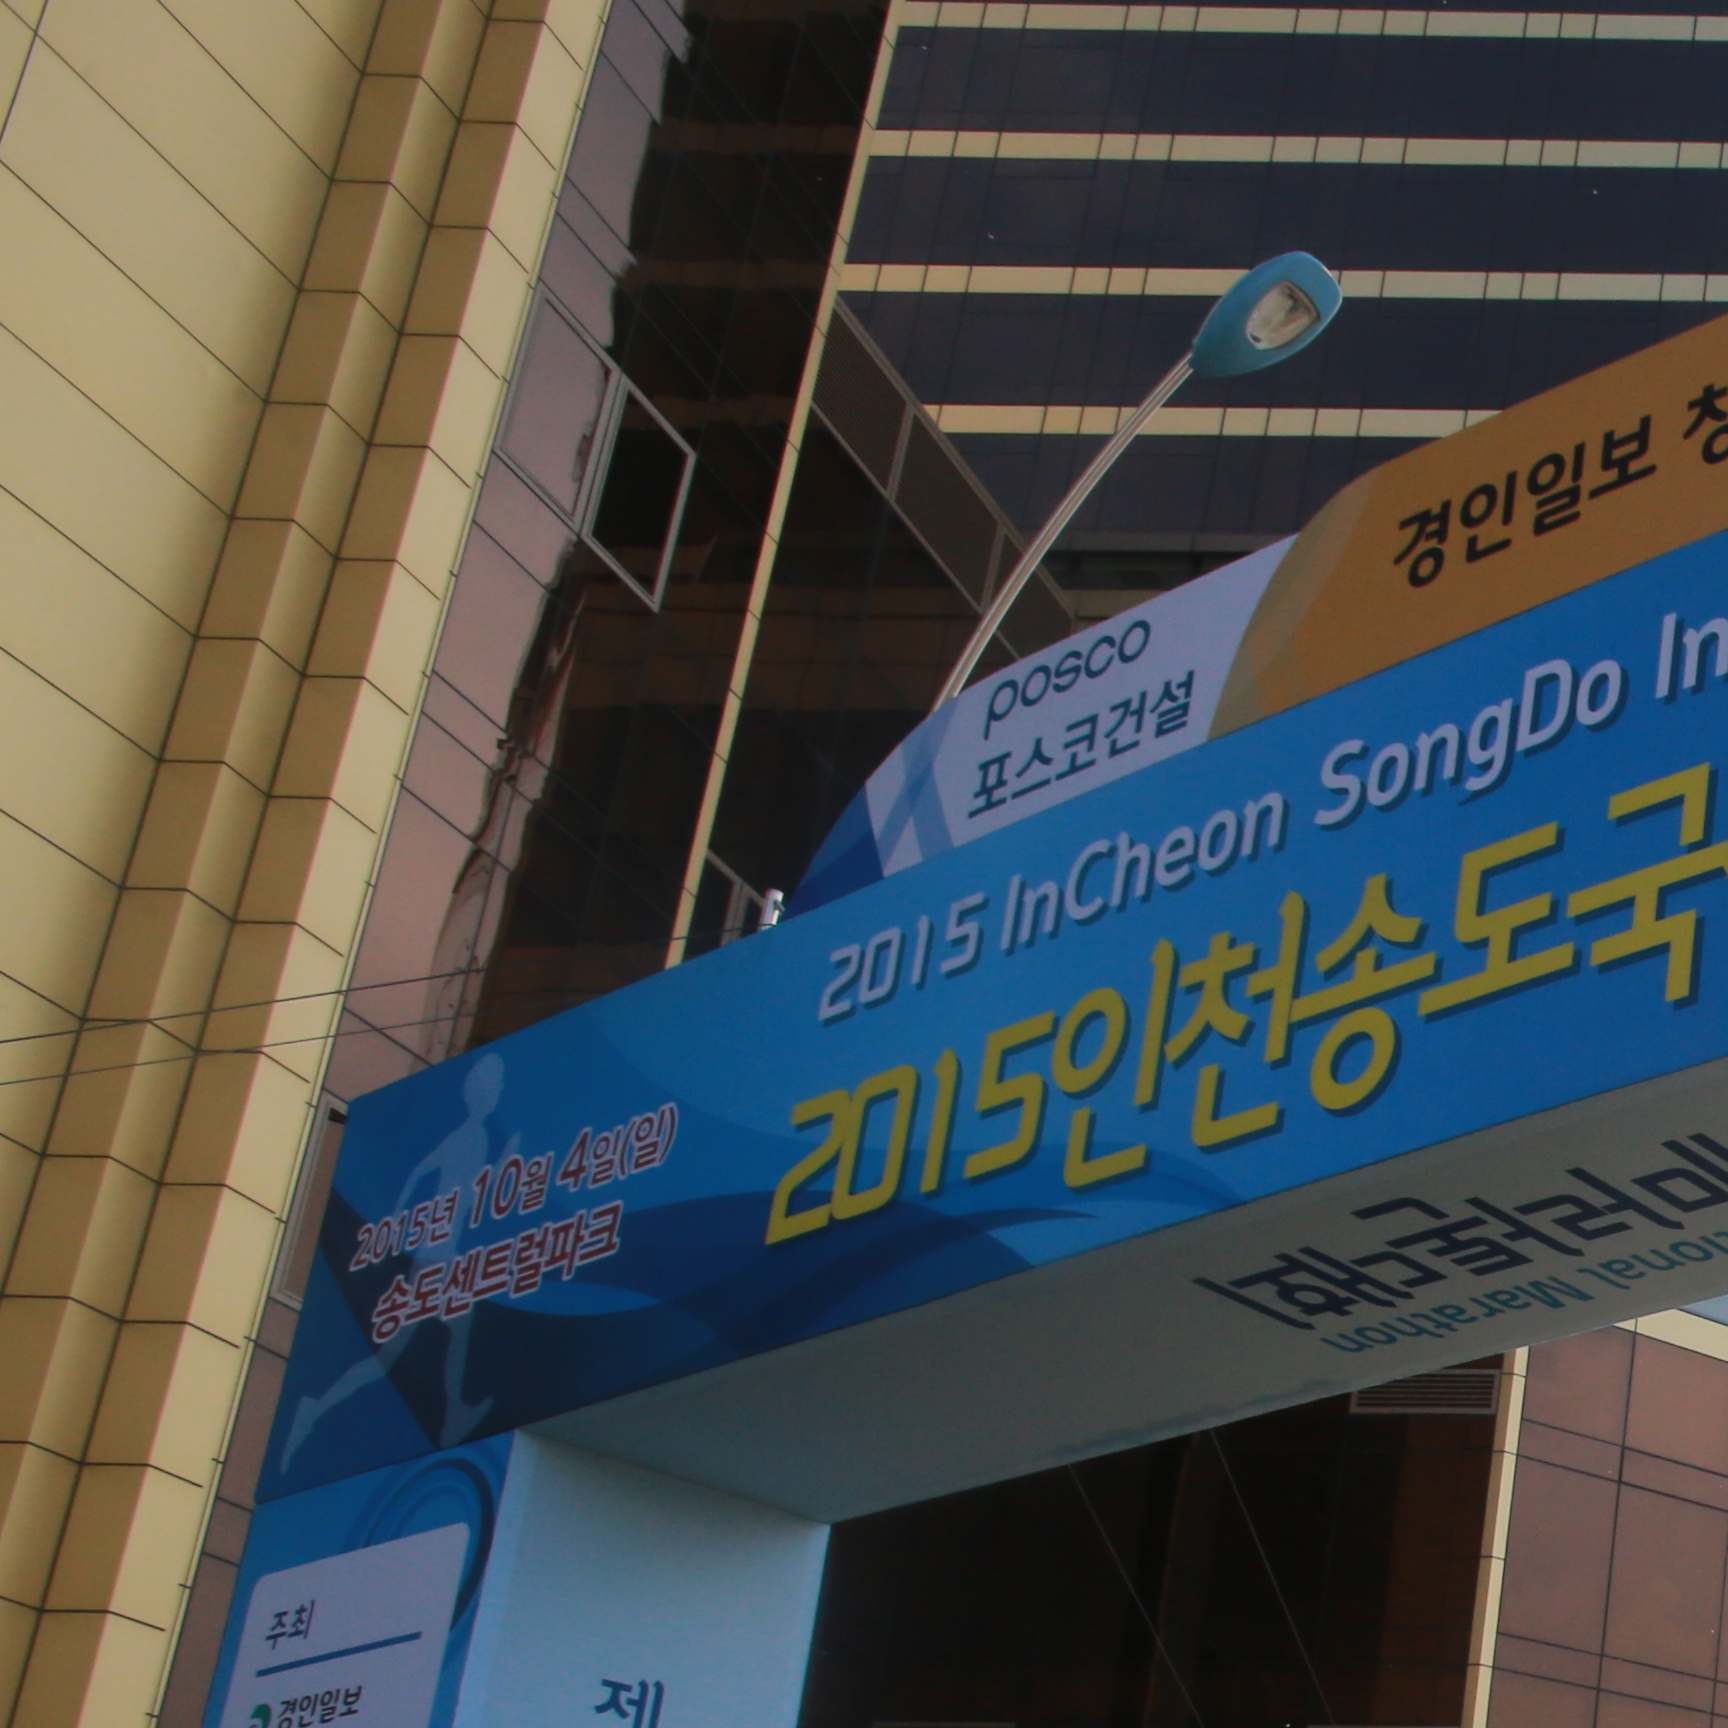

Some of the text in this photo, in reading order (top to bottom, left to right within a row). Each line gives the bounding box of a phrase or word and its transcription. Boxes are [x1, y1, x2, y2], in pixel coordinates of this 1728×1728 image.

[1392, 413, 1659, 591] 경인일보
[966, 670, 1196, 819] 포스코건설
[982, 620, 1150, 740] posco
[818, 892, 982, 1022] 2015
[1002, 794, 1285, 950] InCheon
[1314, 655, 1625, 827] SongDo
[350, 1103, 677, 1271] 2015년 10월 4일(일)
[373, 1201, 623, 1343] 송도센트럴파크
[1320, 1273, 1589, 1355] Marathon
[266, 1599, 315, 1650] 주최
